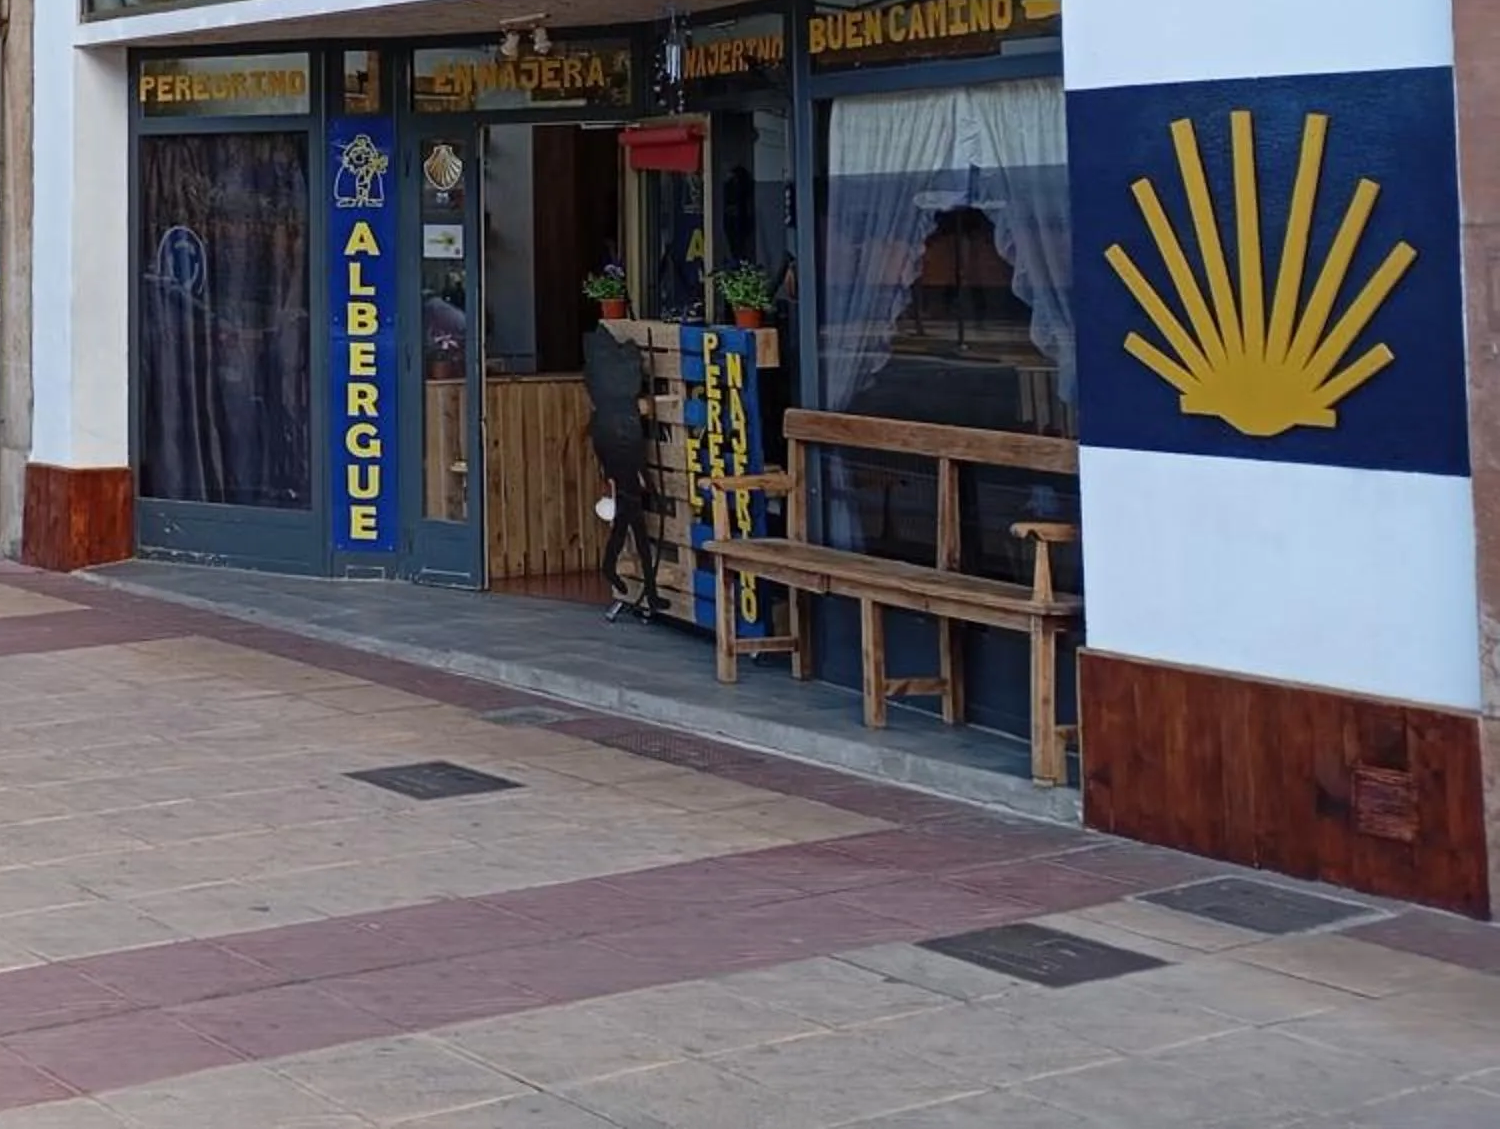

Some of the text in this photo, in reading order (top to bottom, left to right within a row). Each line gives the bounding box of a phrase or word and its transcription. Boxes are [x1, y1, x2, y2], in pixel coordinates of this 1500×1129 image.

[809, 9, 884, 55] BUEN
[139, 69, 306, 103] PEREGRINO
[344, 221, 381, 540] ALBERGUE
